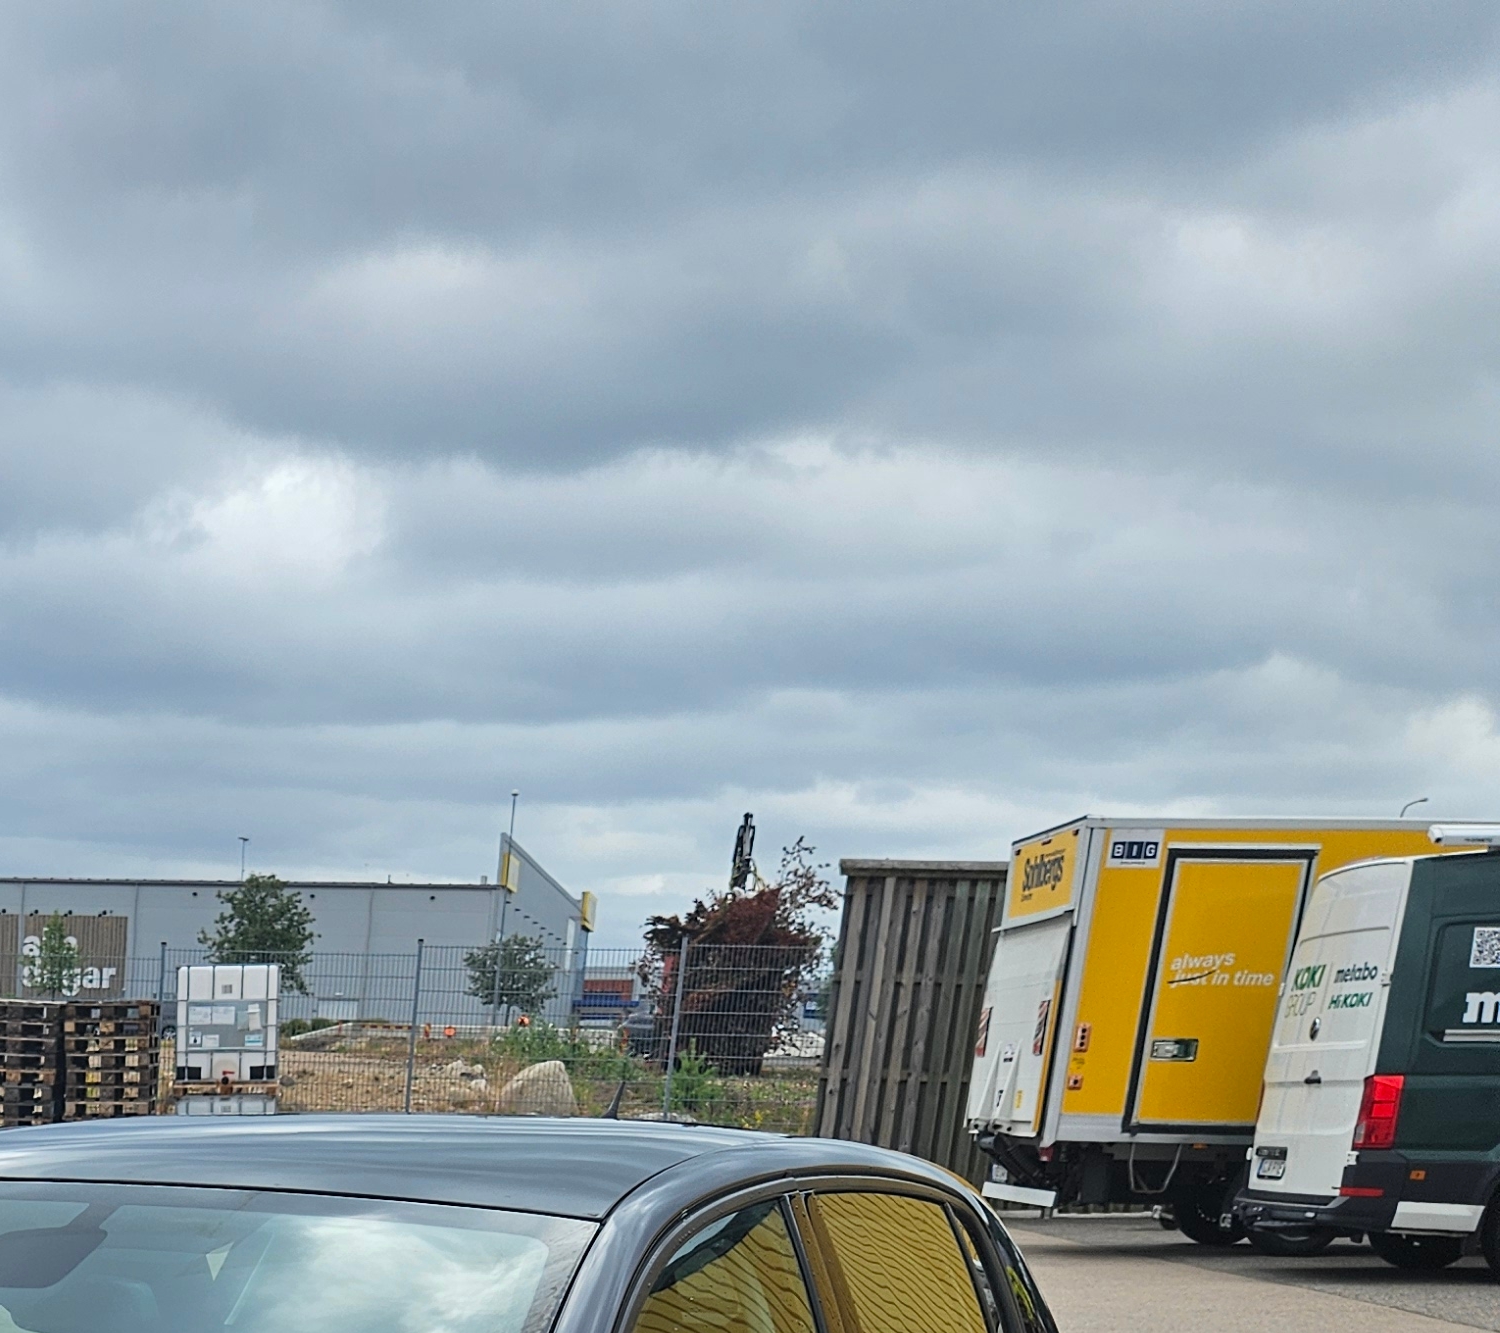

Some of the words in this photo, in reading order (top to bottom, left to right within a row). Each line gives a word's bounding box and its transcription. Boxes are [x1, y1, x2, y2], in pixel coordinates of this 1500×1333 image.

[1113, 843, 1156, 857] BIG
[1170, 952, 1236, 971] always
[1211, 969, 1230, 986] in
[1233, 969, 1274, 986] time
[1291, 964, 1327, 991] KOKI
[1333, 962, 1379, 984] metabo
[1327, 992, 1374, 1010] HiKOKI
